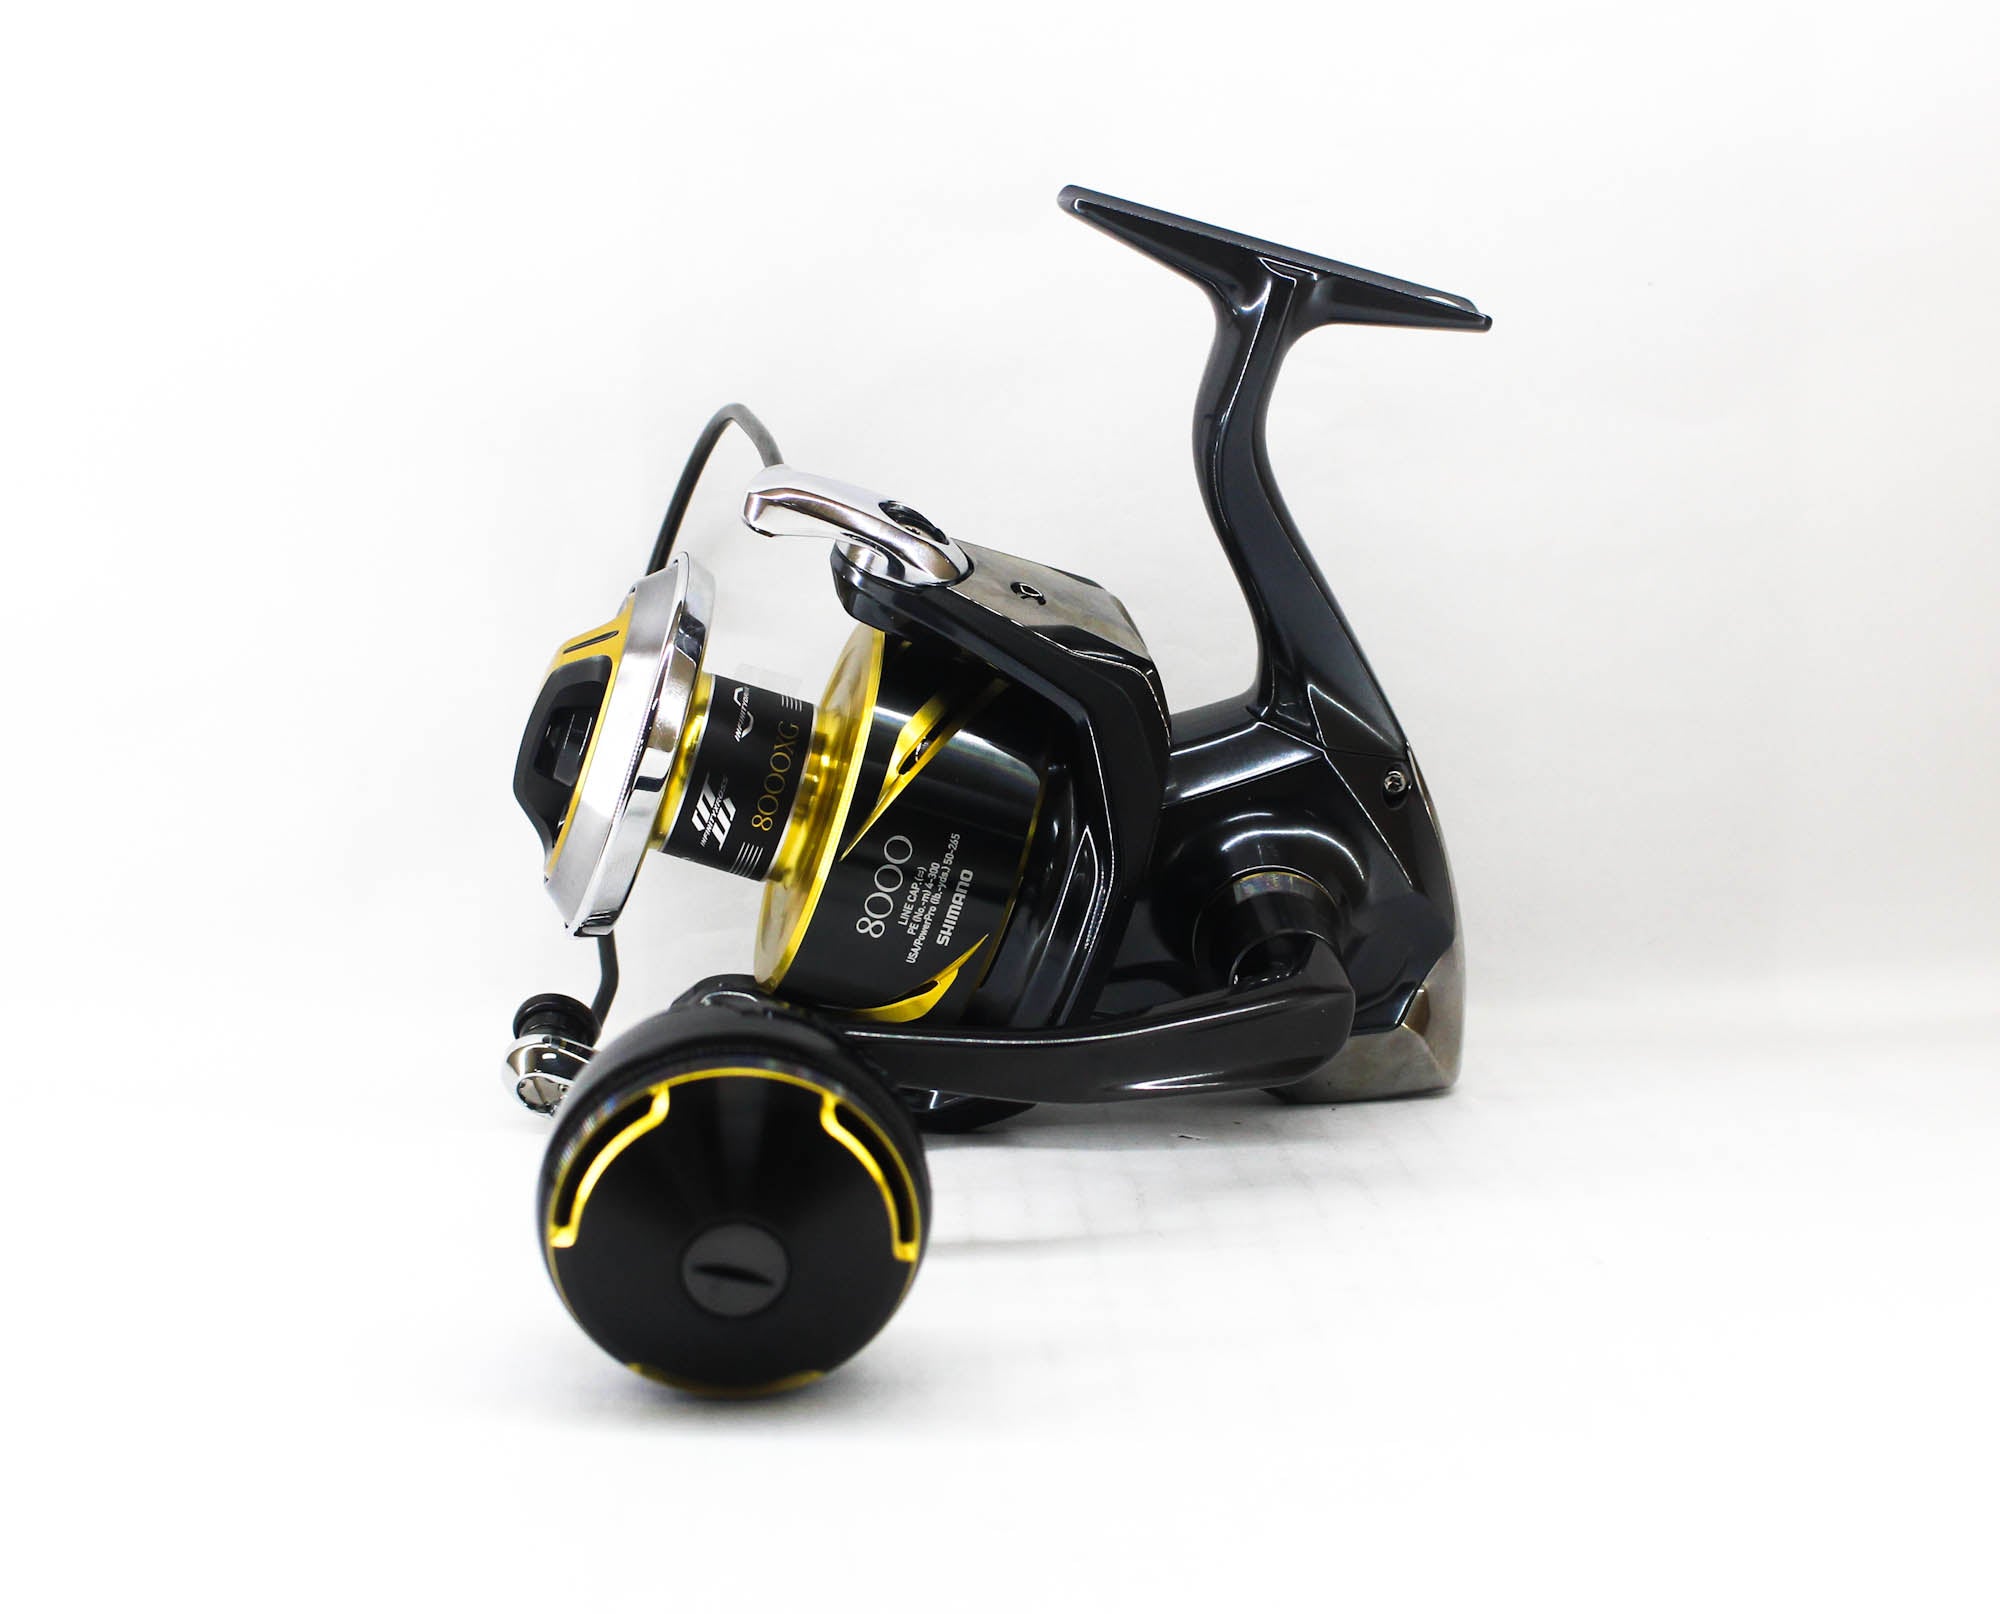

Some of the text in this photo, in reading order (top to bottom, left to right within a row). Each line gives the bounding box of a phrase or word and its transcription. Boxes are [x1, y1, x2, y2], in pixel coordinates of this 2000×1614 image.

[751, 720, 800, 832] 8000XG
[856, 835, 913, 938] 8000
[898, 902, 915, 926] LINE
[906, 905, 937, 964] USA/PowerPro
[943, 833, 961, 866] 50-265
[907, 862, 941, 936] PE (No.-m) 4-300
[936, 869, 974, 947] SHIMANO
